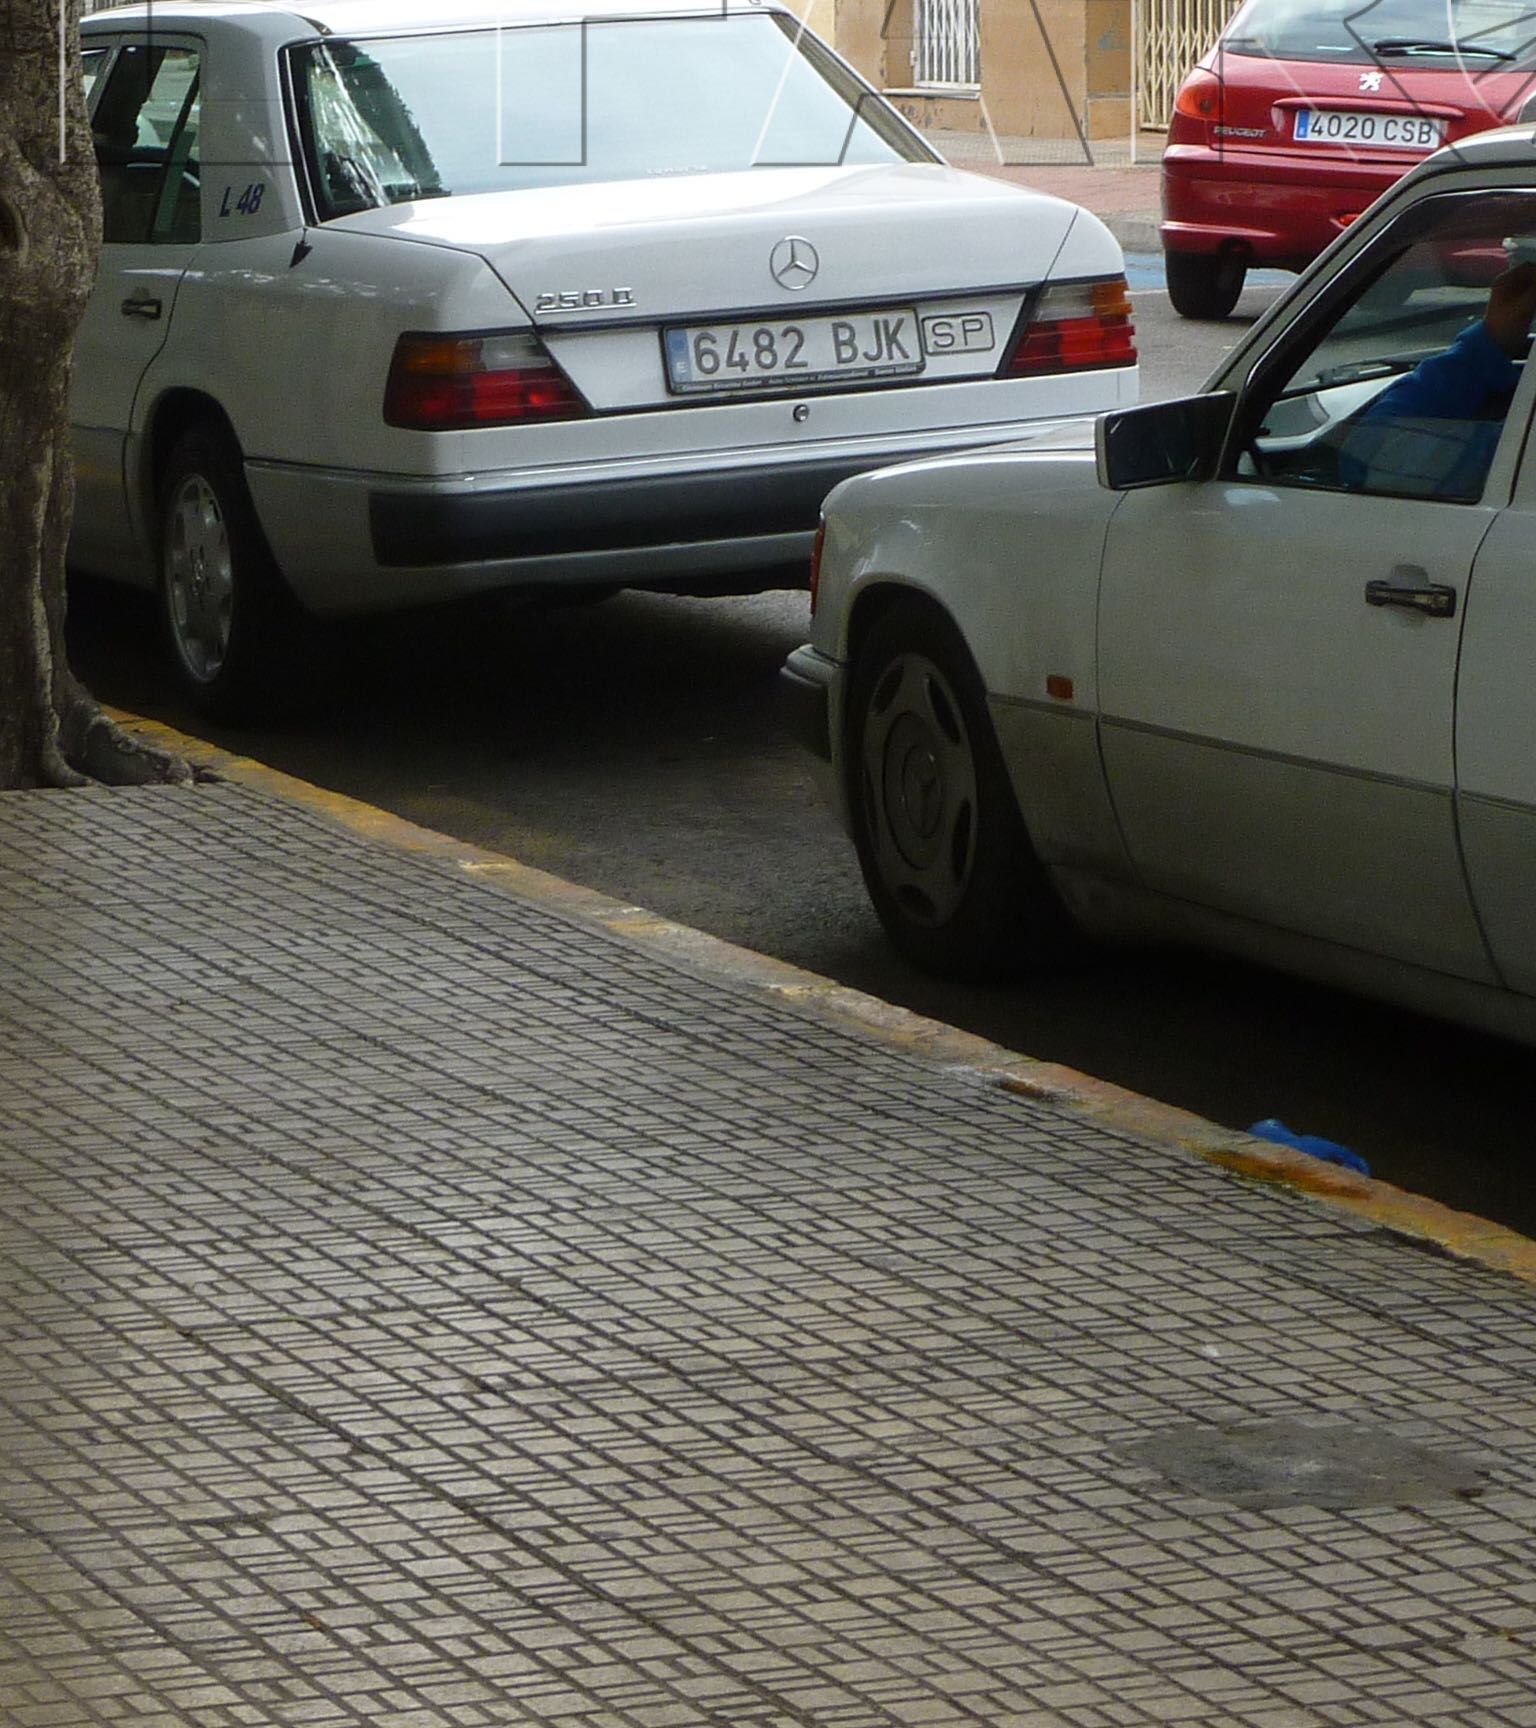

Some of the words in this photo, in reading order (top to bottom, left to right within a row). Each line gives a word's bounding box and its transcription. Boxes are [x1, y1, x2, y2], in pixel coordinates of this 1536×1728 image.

[1213, 125, 1267, 139] PEUGEOT
[1311, 114, 1376, 141] 4020
[1383, 118, 1434, 145] CSB
[236, 183, 265, 216] 48
[536, 288, 604, 310] 250
[693, 326, 810, 376] 6482
[831, 316, 911, 365] BJK
[932, 316, 985, 349] SP
